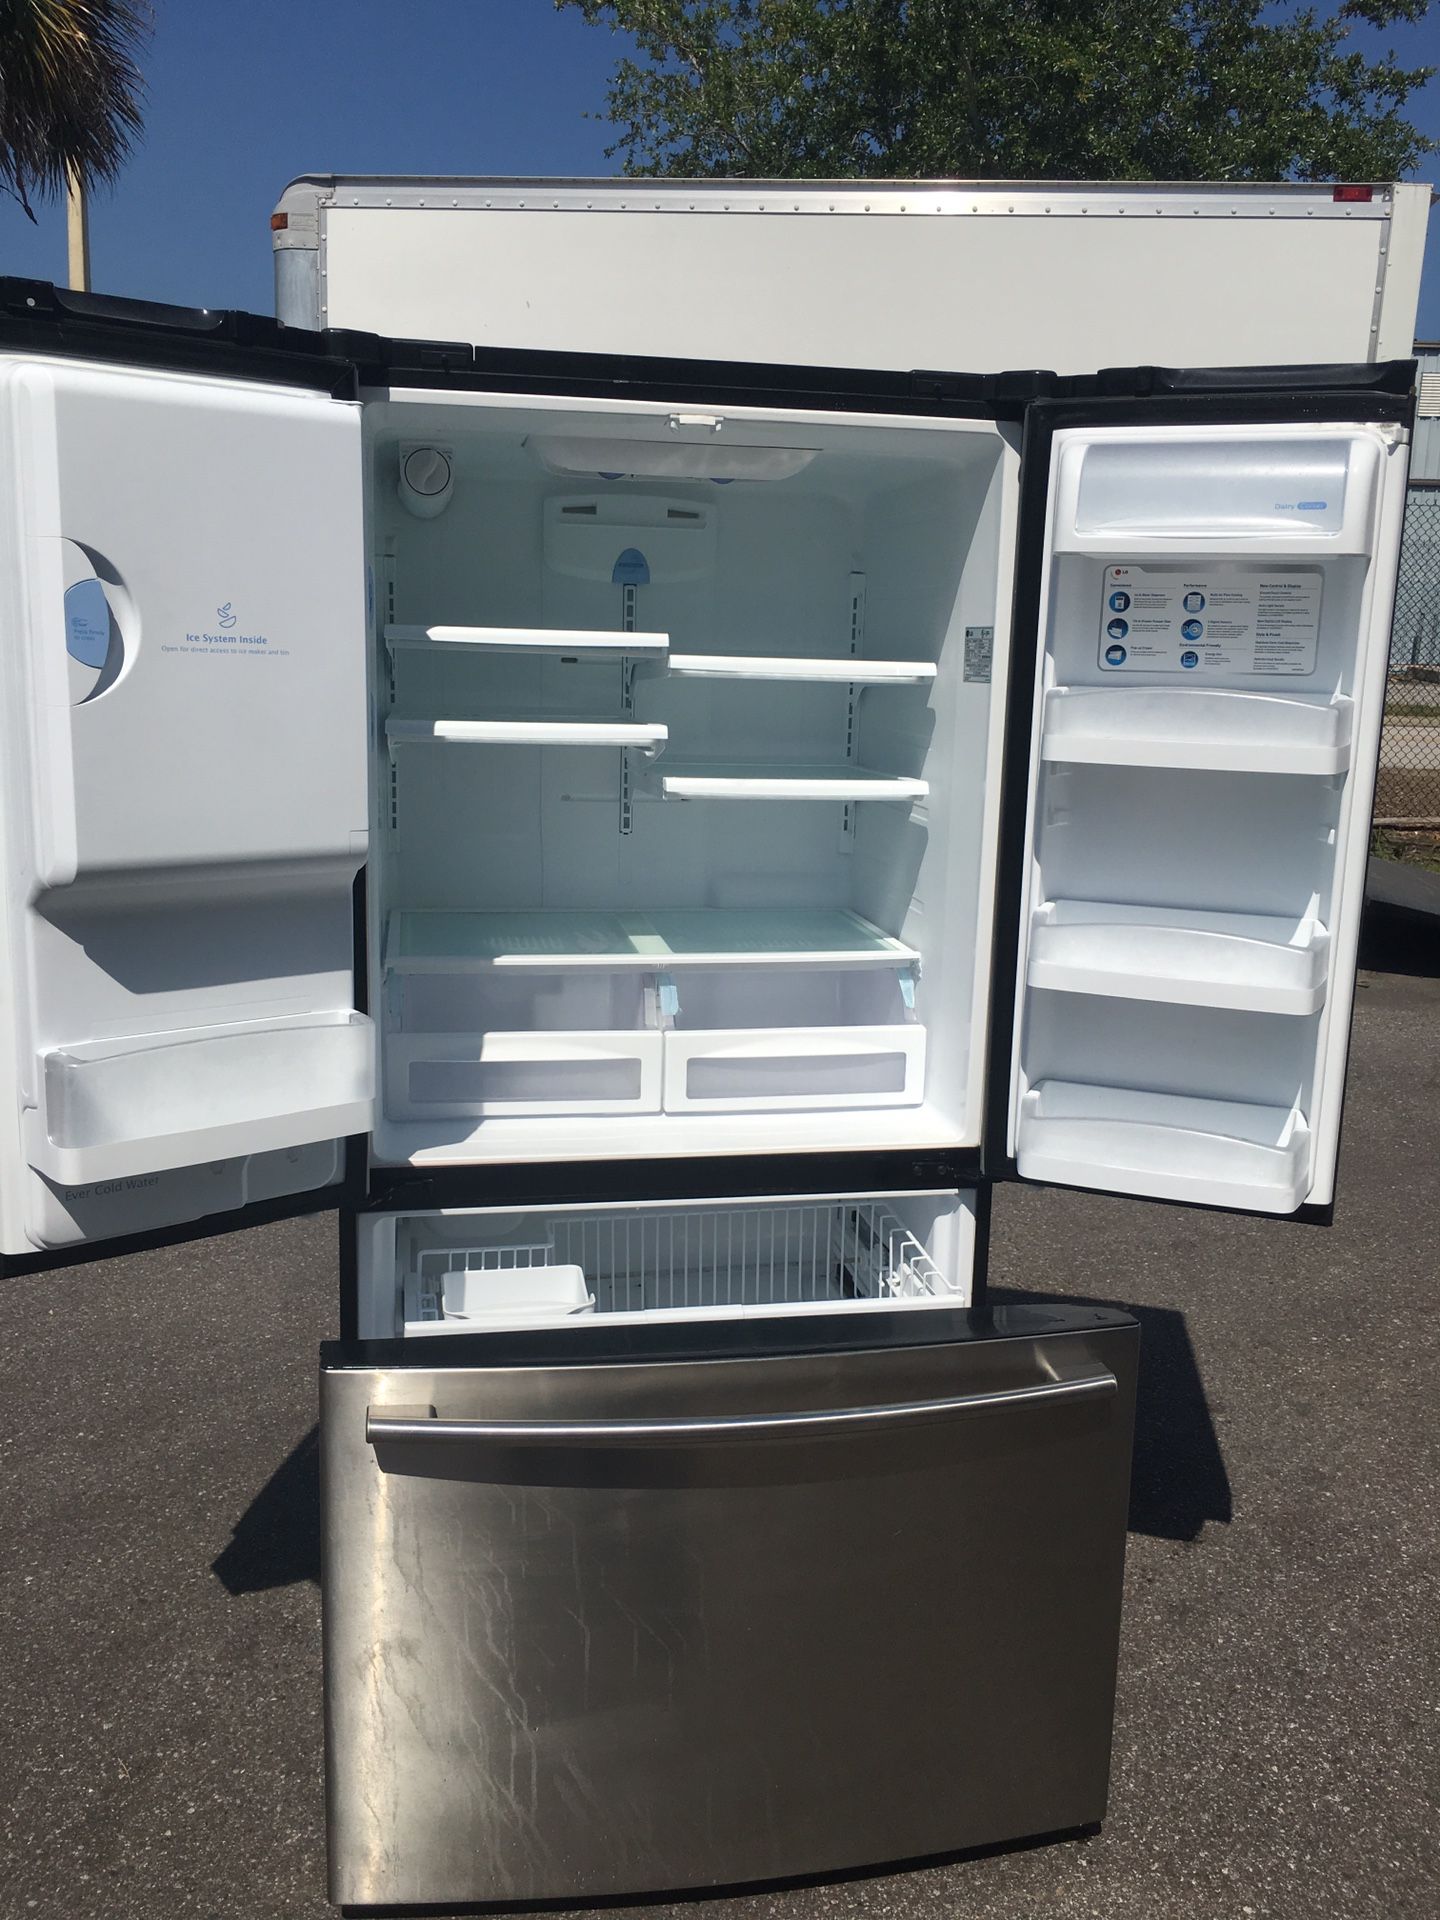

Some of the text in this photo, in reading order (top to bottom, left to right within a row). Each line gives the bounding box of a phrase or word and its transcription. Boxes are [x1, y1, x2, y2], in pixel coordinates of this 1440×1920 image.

[186, 633, 268, 644] Ice System Inside
[161, 645, 179, 653] Open
[65, 1177, 159, 1201] Ever Cold Water
